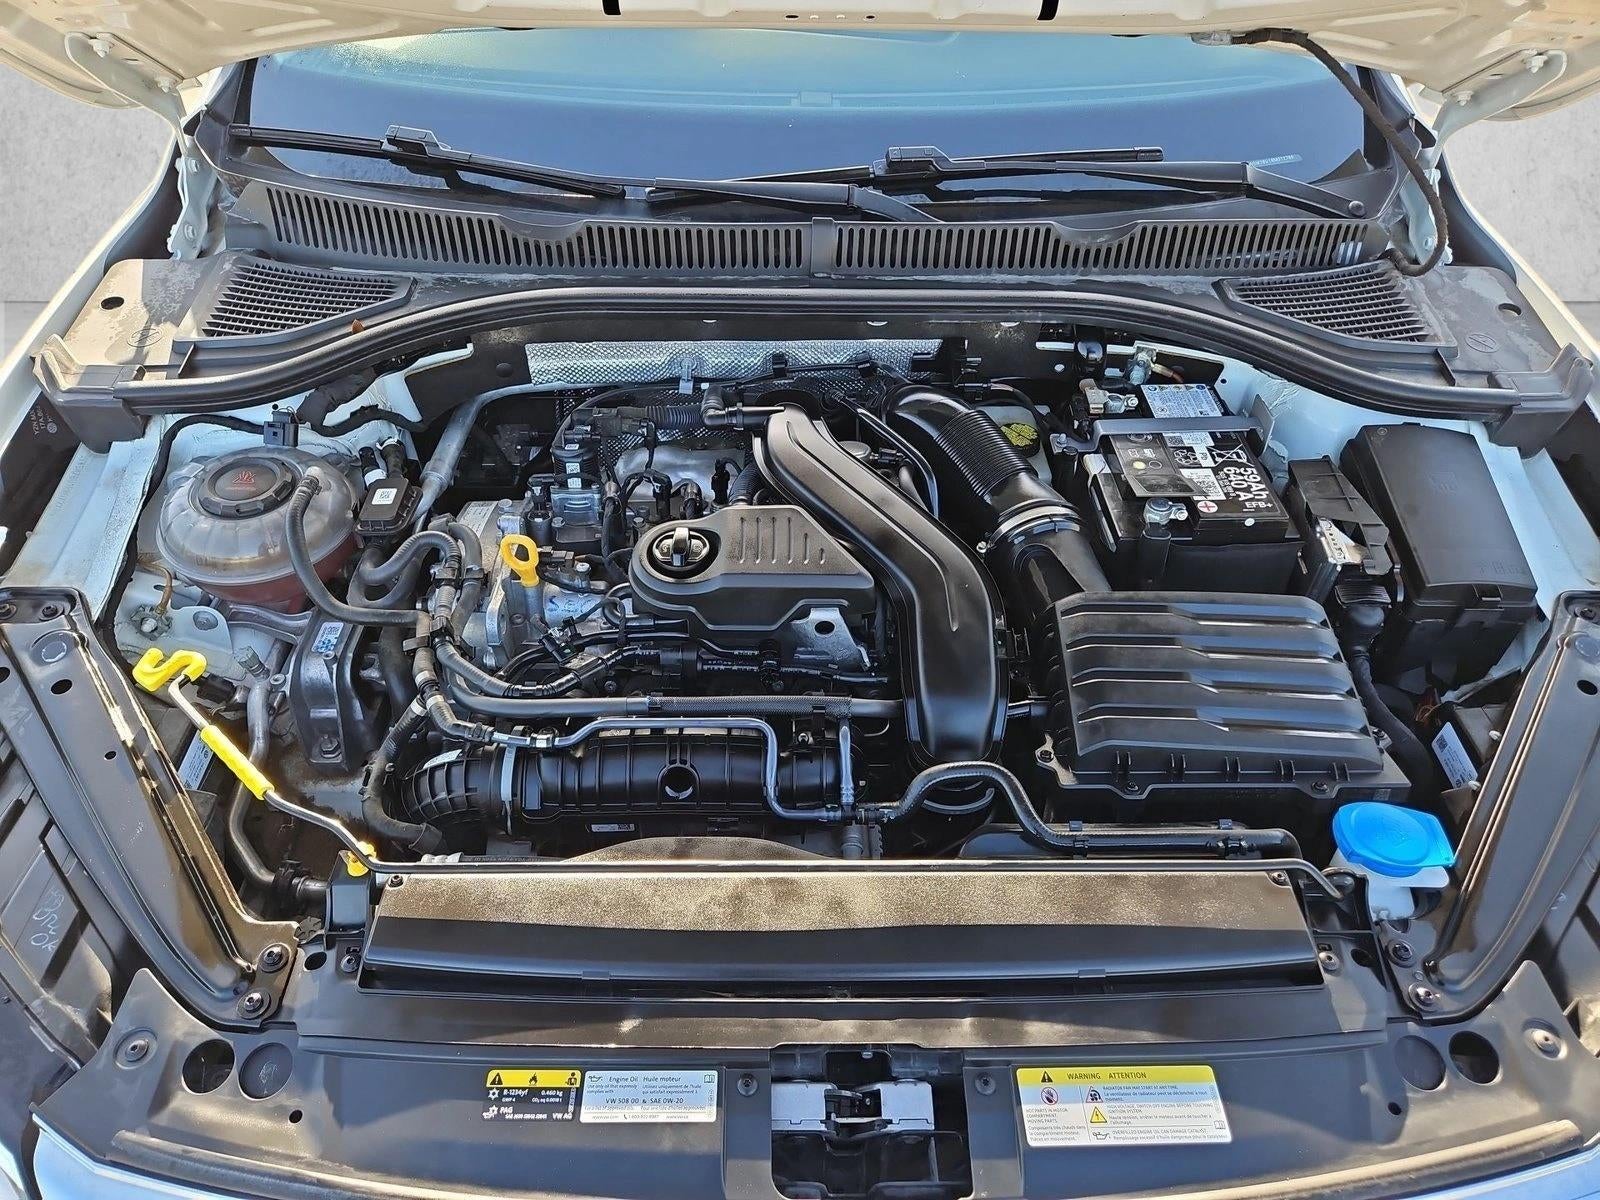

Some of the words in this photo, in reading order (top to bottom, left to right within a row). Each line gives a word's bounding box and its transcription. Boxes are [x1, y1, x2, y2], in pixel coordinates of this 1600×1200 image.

[1199, 452, 1207, 460] Pb
[1224, 467, 1247, 488] 640
[1240, 468, 1269, 499] 59Ah
[1235, 491, 1254, 501] A
[503, 1089, 528, 1097] R-1234yf
